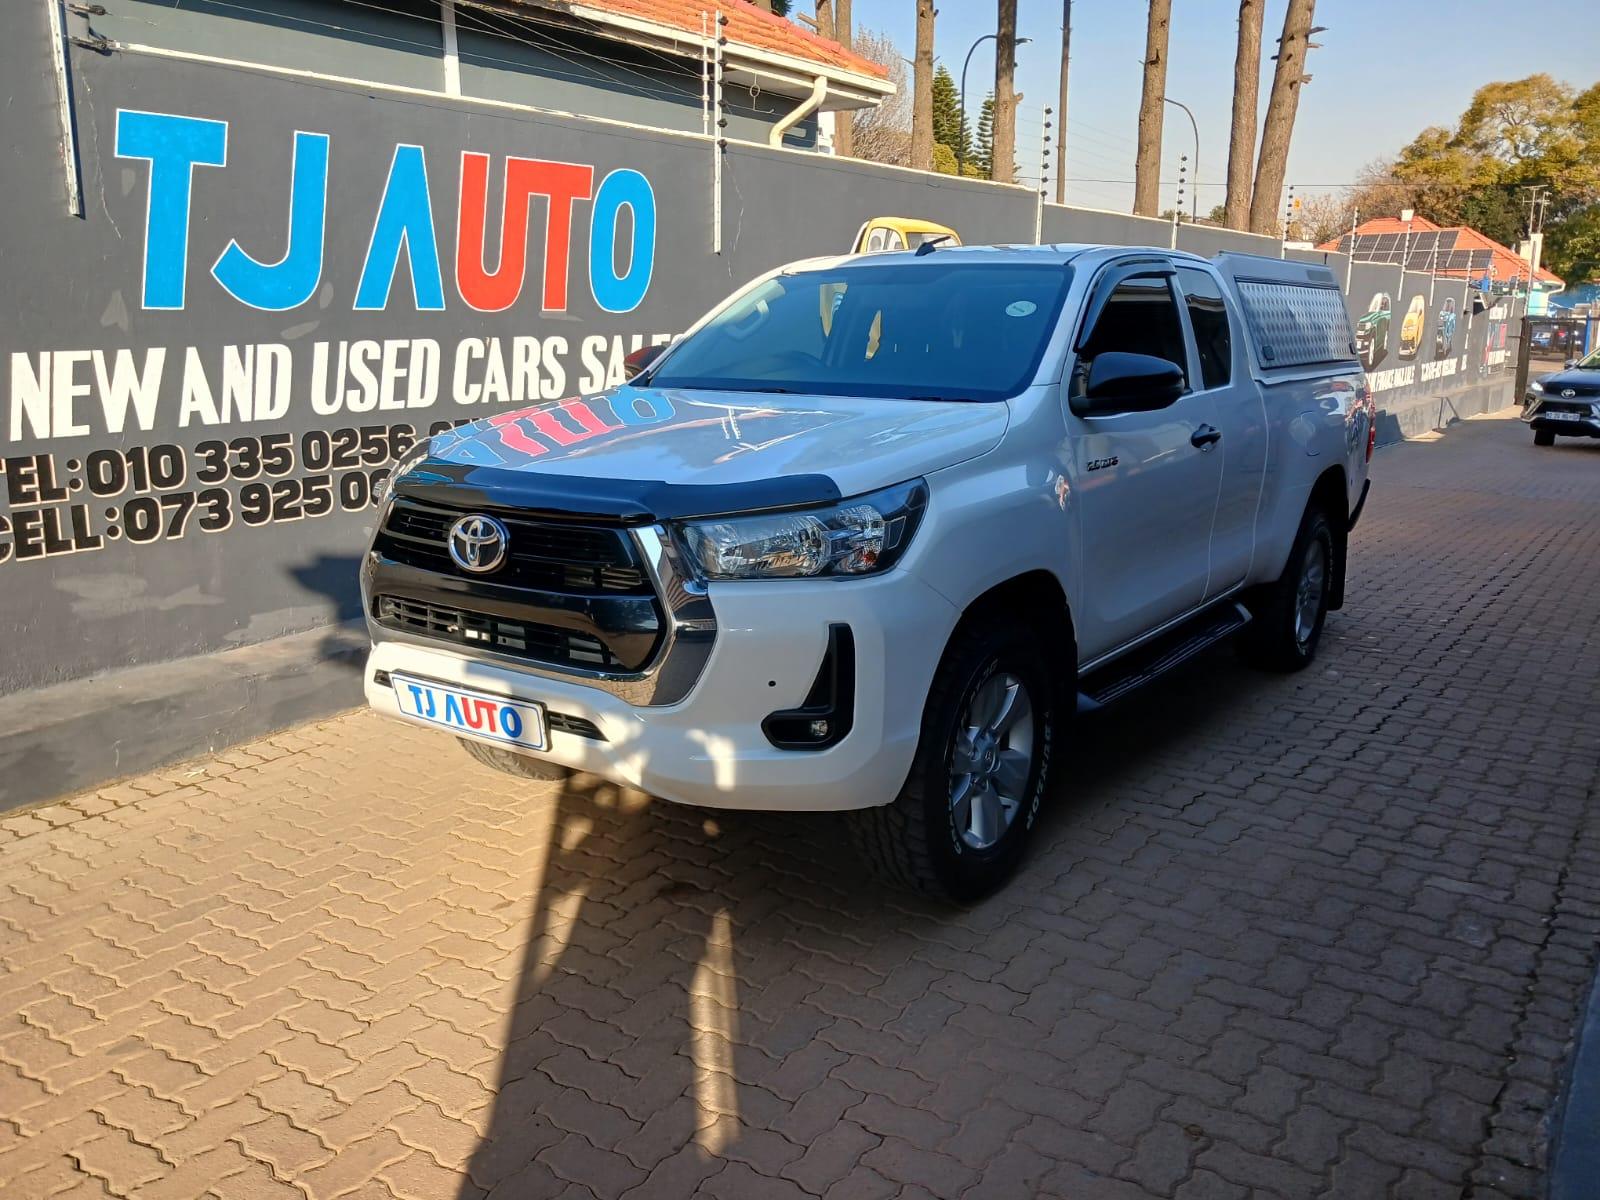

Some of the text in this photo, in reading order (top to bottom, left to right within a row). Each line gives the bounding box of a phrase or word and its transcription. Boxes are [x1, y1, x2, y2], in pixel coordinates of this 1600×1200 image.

[114, 108, 657, 314] TJ AUTO
[9, 347, 166, 442] NEW
[178, 343, 293, 428] AND
[311, 338, 441, 415] USED
[452, 336, 569, 405] CARS
[0, 424, 416, 508] EL:010 335 0256
[239, 475, 334, 526] 925
[408, 684, 523, 738] TJ AUTO
